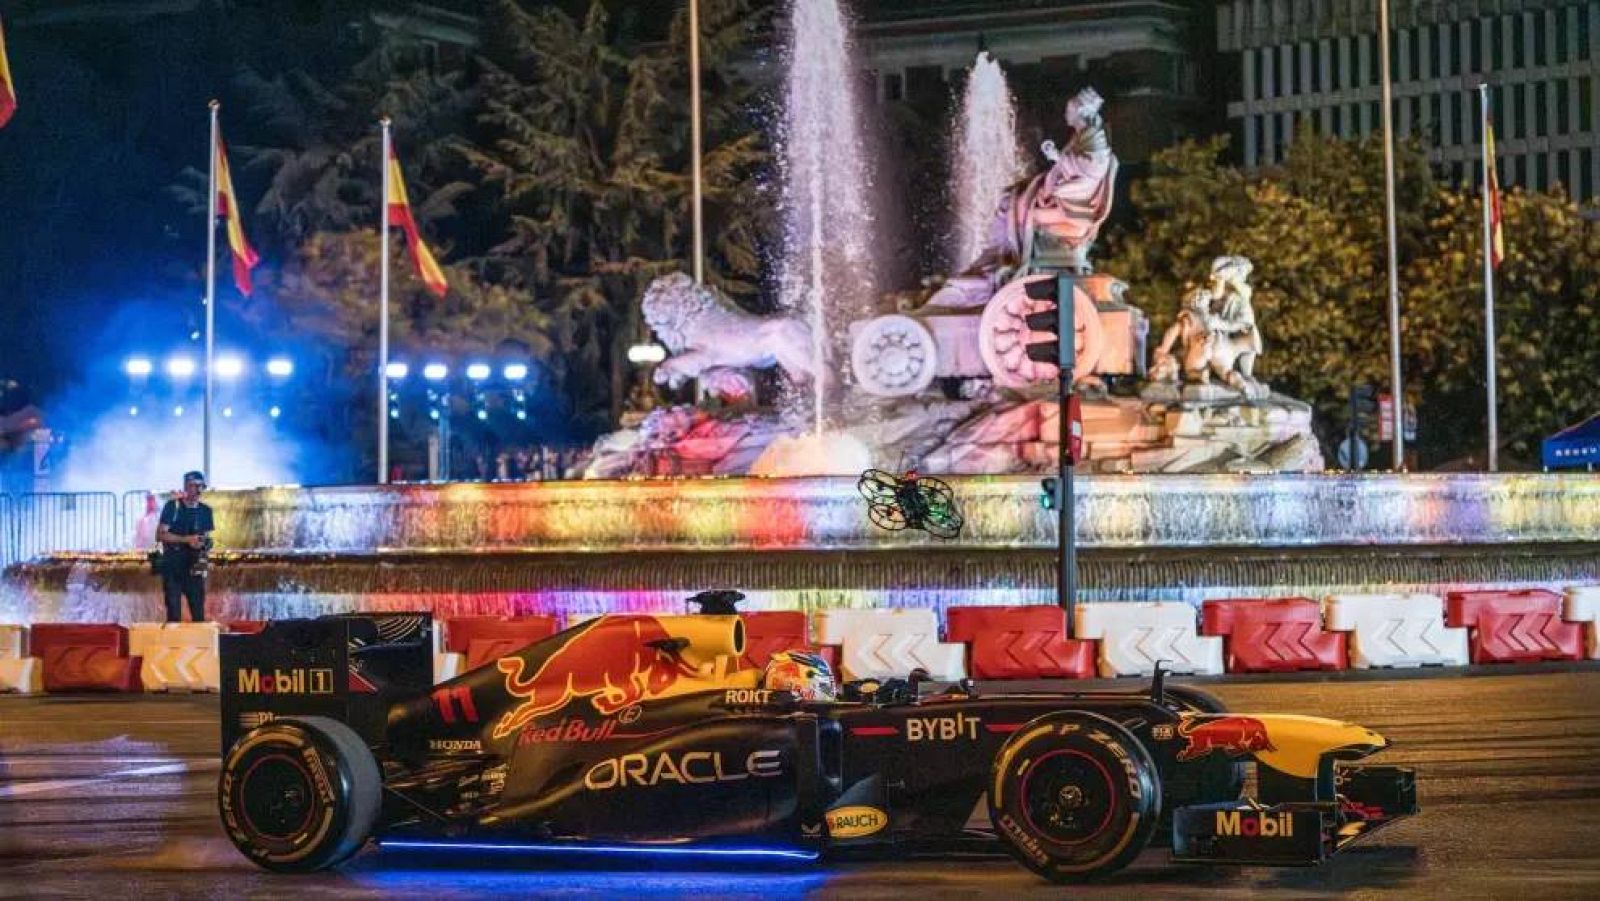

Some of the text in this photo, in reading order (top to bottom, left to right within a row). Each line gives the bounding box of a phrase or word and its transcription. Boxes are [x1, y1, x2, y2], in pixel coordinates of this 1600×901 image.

[238, 668, 305, 693] Mobil
[431, 684, 479, 724] 11
[725, 689, 773, 704] ROKT
[518, 718, 617, 746] Red Bull
[906, 712, 982, 742] BYBIT
[430, 740, 481, 750] HONDA
[585, 750, 783, 790] ORACLE
[1059, 724, 1142, 800] P ZERO
[836, 814, 879, 829] RAUCH
[1216, 811, 1294, 837] Mobil
